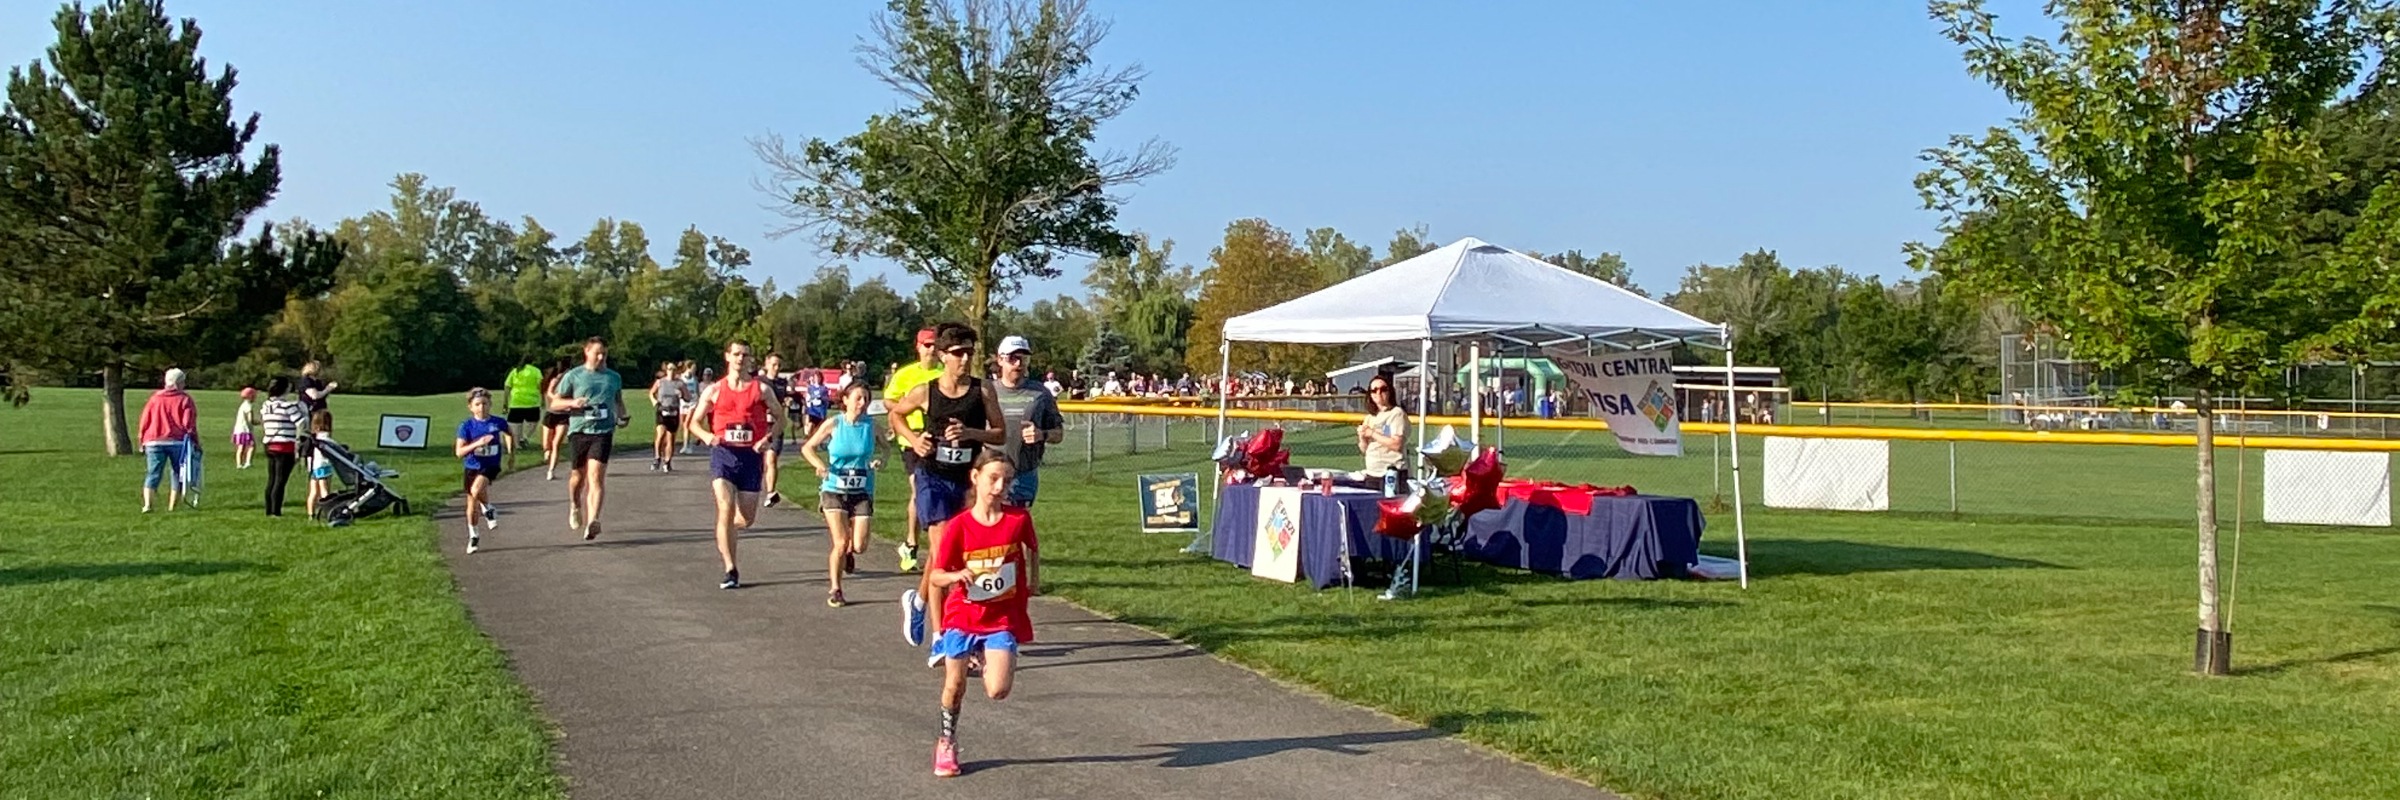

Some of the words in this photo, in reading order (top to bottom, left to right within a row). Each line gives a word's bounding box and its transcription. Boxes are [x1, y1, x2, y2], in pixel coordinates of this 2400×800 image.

[946, 450, 963, 462] 12
[842, 477, 862, 488] 147
[982, 577, 1004, 592] 60
